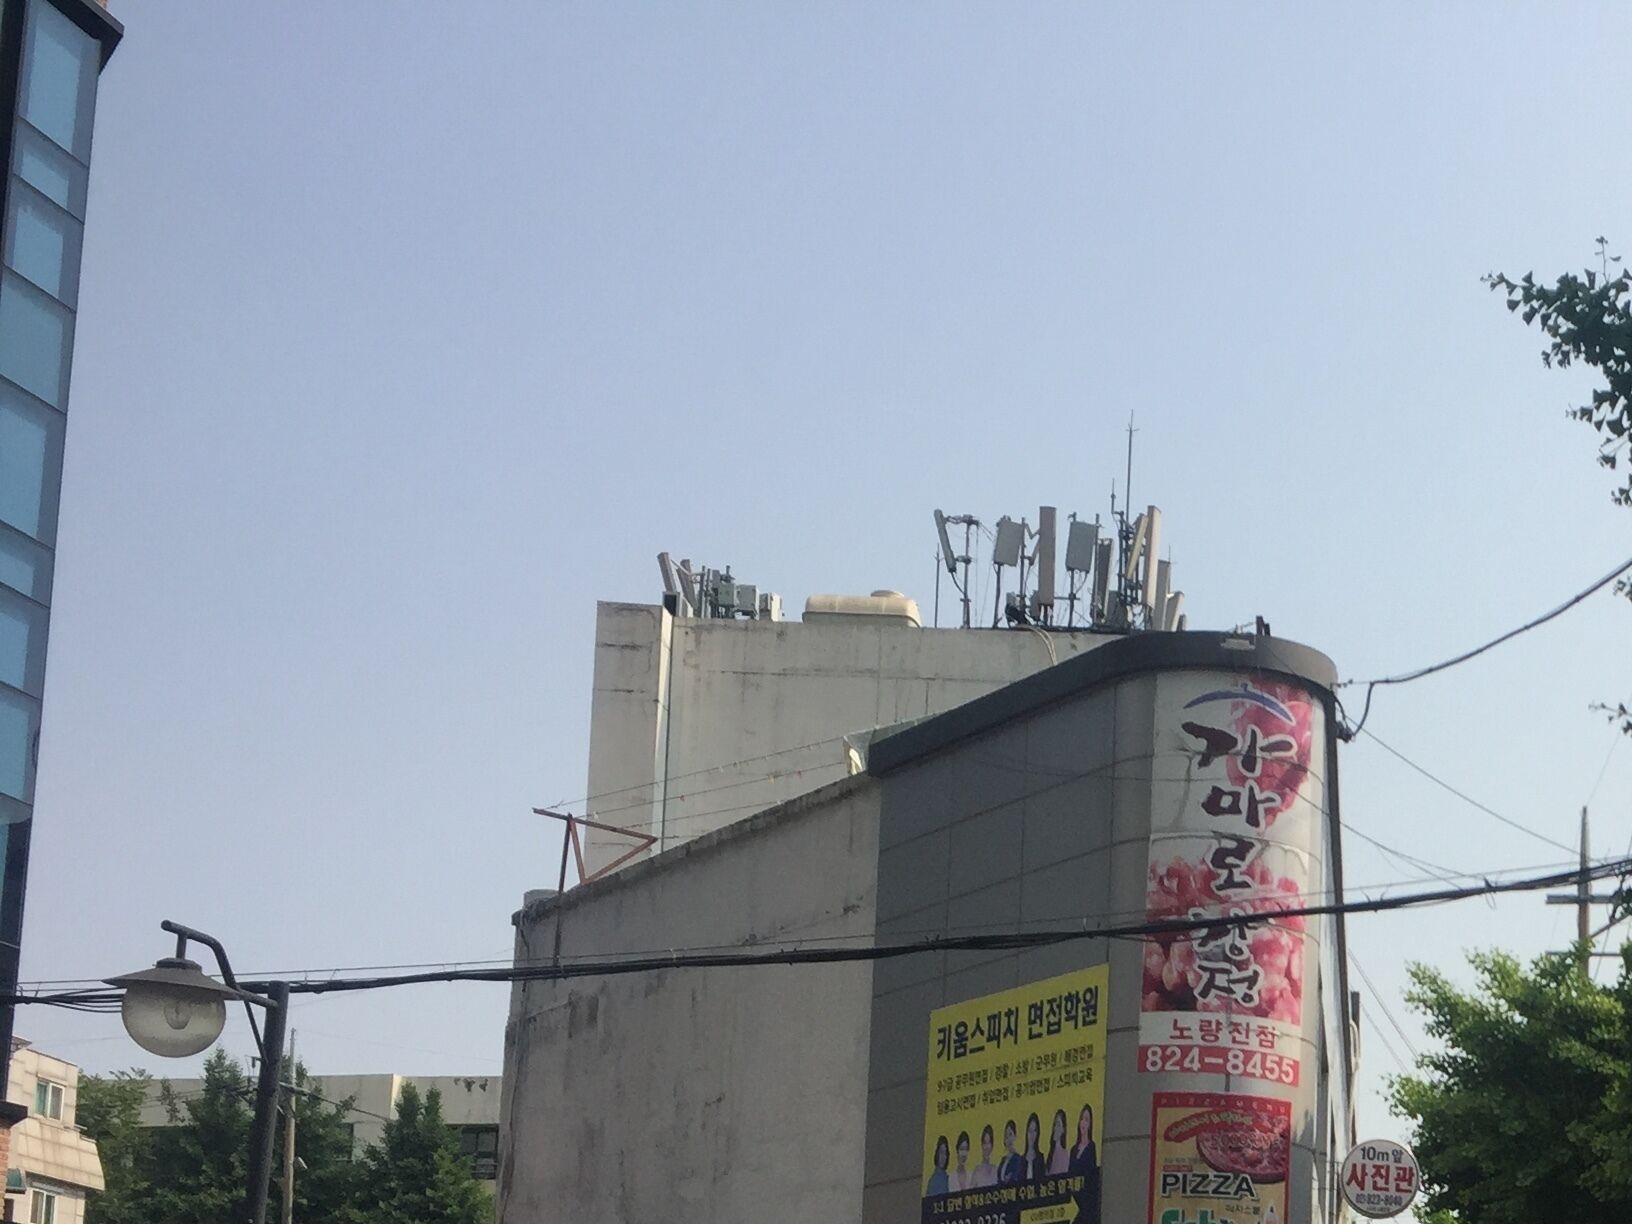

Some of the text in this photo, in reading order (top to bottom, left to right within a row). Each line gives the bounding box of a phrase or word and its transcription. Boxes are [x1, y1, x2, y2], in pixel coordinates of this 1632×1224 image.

[936, 985, 1099, 1062] 키움스피치 면접학원
[1169, 1017, 1279, 1049] 노량진점
[1144, 1046, 1296, 1085] 824-8455
[1361, 1146, 1390, 1161] 10m
[1161, 1173, 1256, 1198] PIZZA
[1346, 1162, 1416, 1194] 사진관
